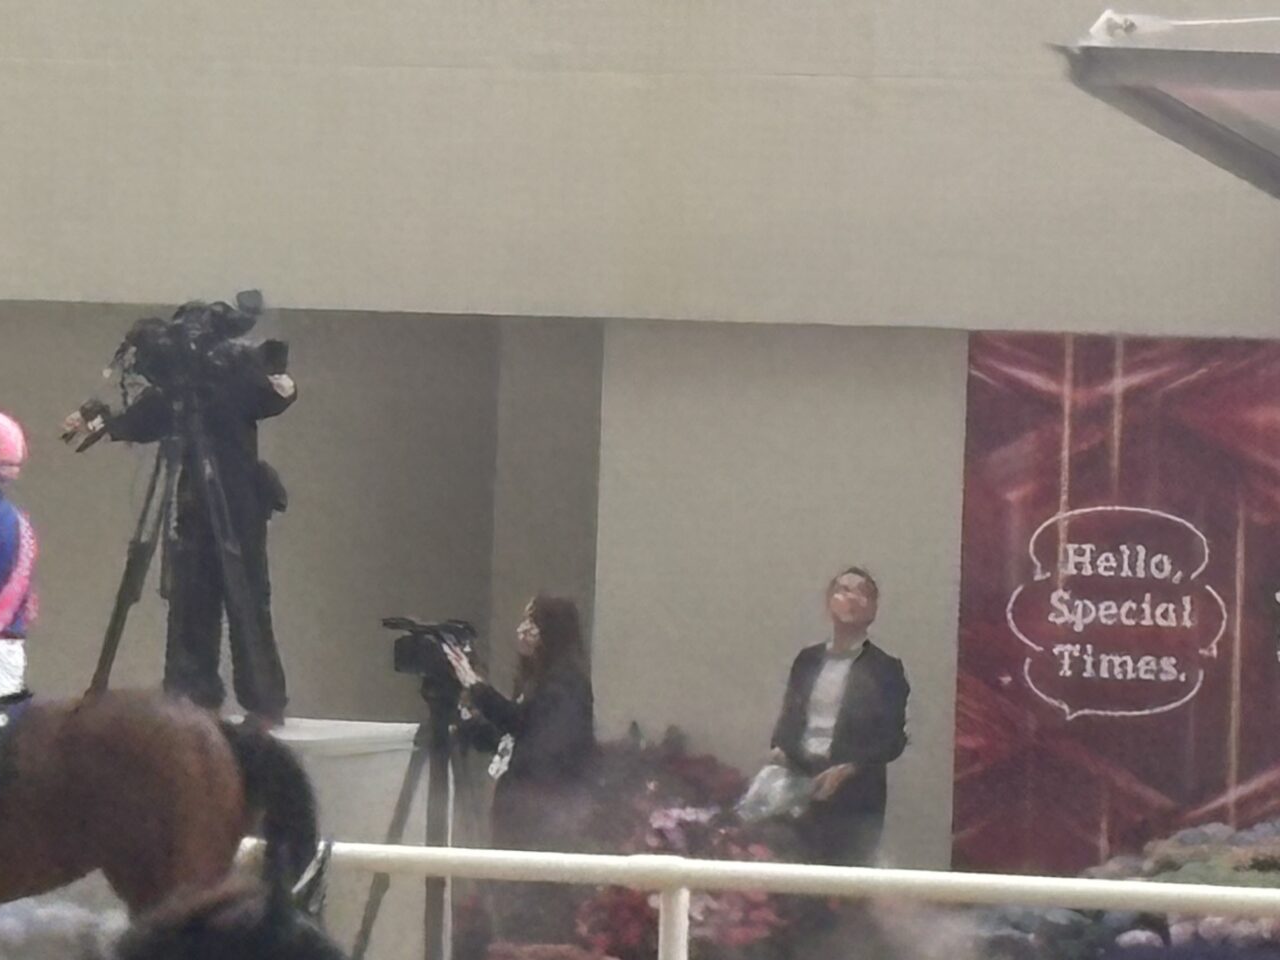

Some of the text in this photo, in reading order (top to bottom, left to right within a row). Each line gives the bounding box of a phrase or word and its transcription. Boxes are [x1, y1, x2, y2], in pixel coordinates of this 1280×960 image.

[1064, 544, 1183, 584] Hello,
[1048, 589, 1194, 632] Special
[1053, 644, 1186, 682] Times.
